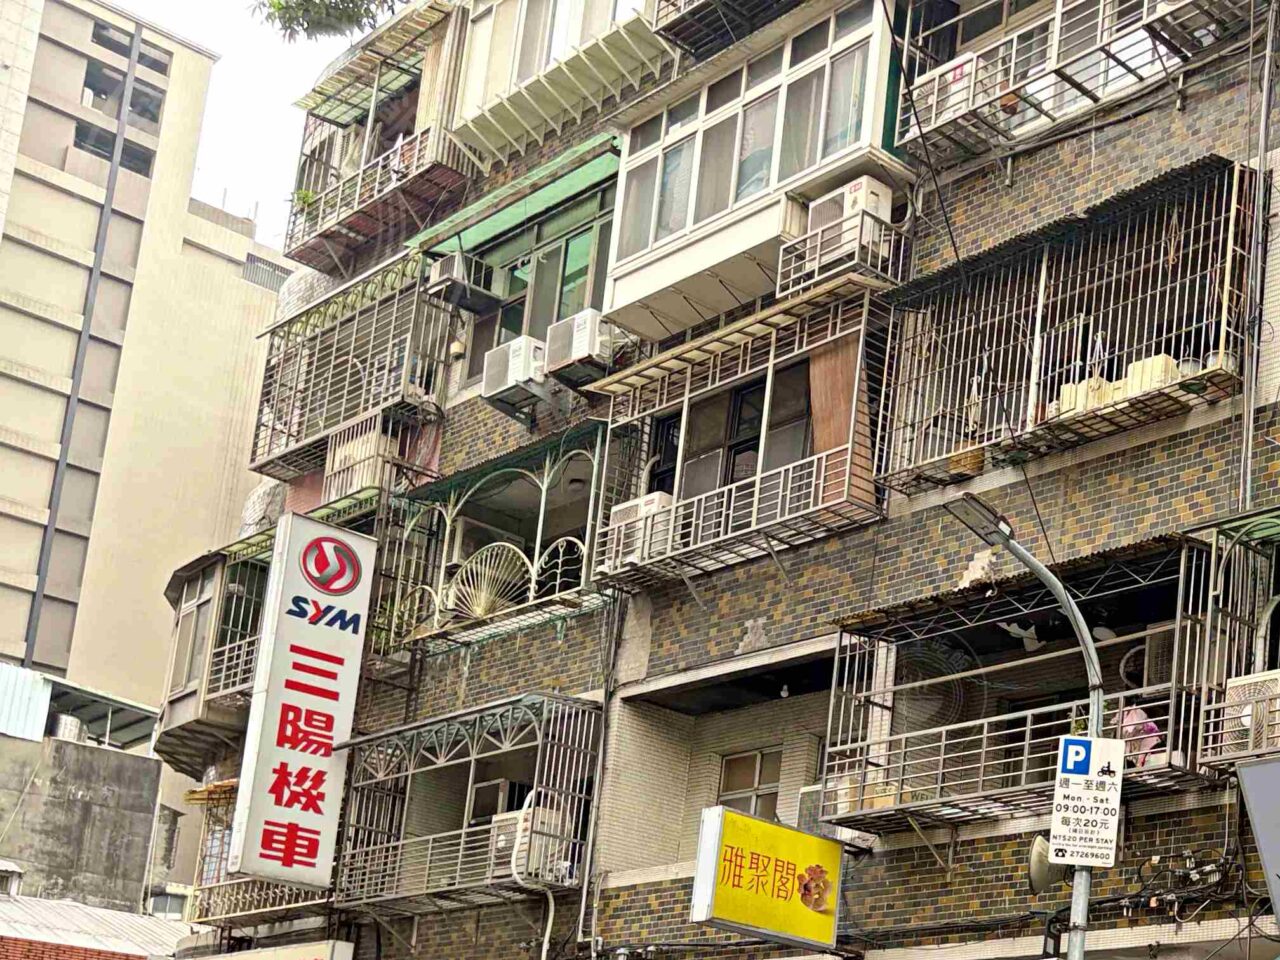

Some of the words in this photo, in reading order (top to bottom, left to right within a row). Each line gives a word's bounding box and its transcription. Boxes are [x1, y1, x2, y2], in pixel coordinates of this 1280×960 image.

[286, 596, 362, 635] SYM
[259, 644, 345, 868] 三陽機車
[1066, 744, 1087, 770] P
[1059, 777, 1118, 793] 週一至週六
[1063, 793, 1082, 802] Mon
[1093, 796, 1109, 804] Sat
[1061, 816, 1110, 830] 每次20元
[1070, 850, 1110, 860] 27269600
[720, 844, 798, 903] 雅聚閣
